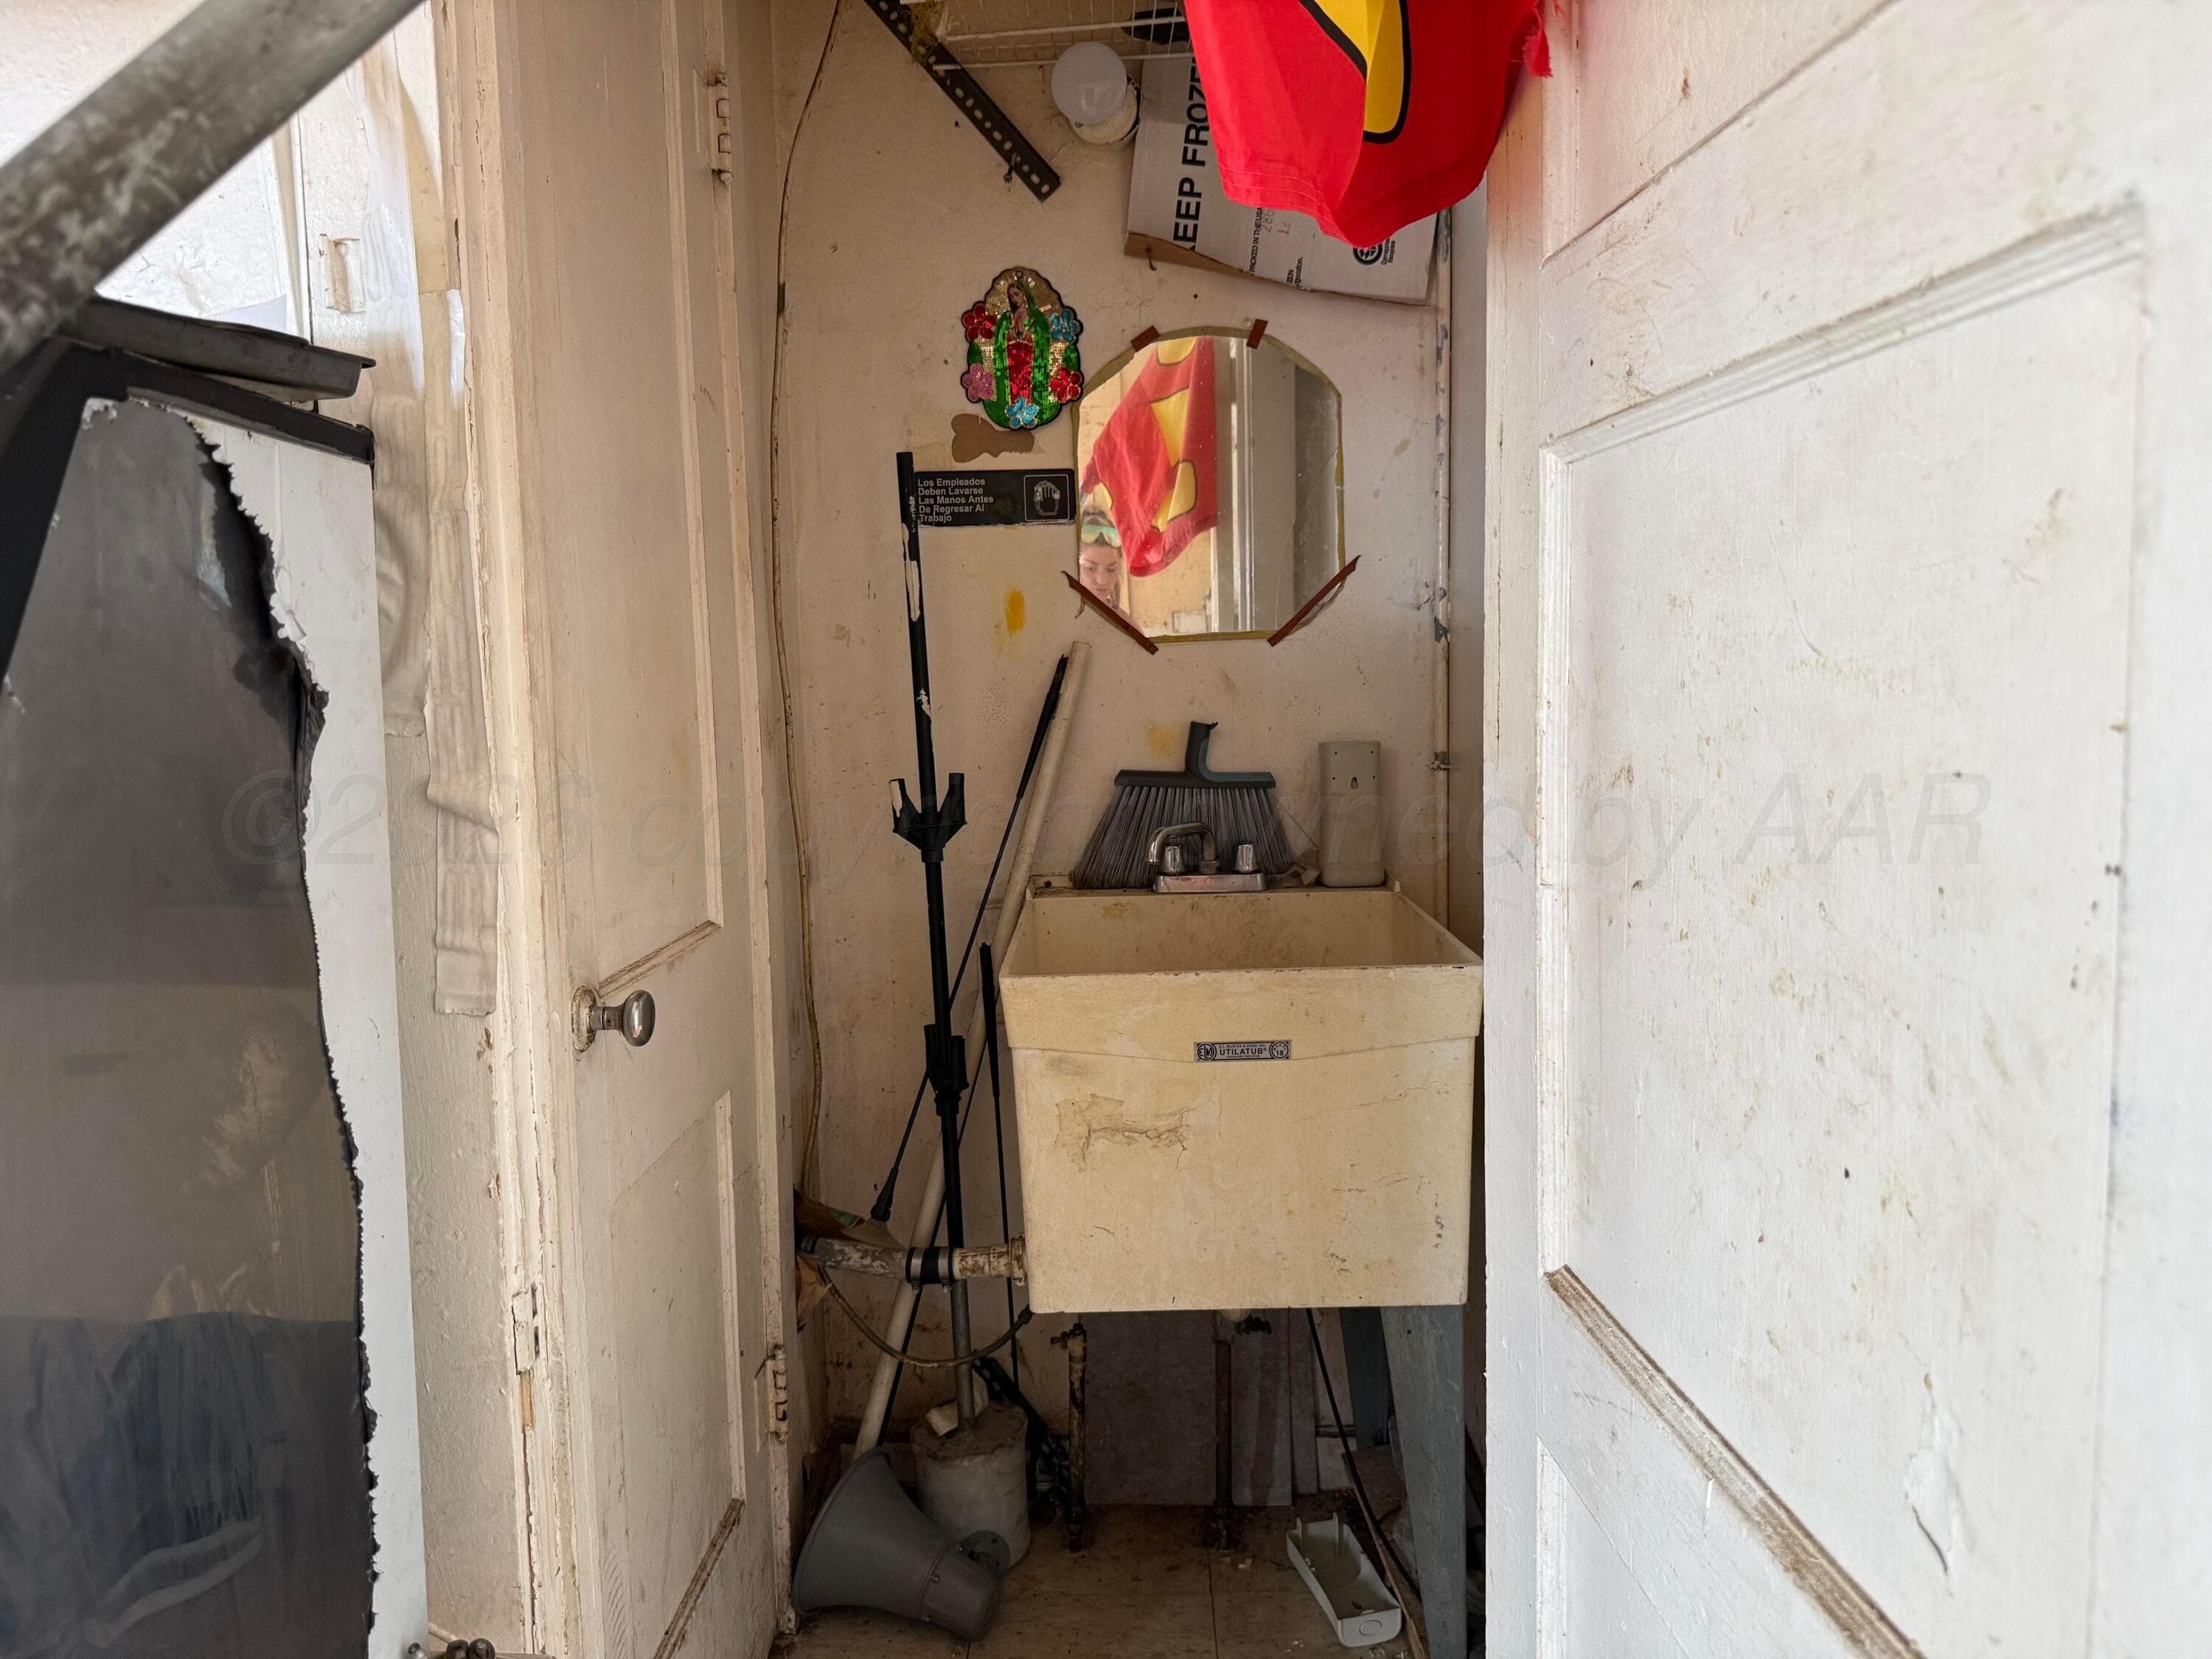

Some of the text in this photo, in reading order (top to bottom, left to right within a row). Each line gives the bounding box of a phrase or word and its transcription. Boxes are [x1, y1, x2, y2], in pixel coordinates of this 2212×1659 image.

[1173, 177, 1202, 252] EEP
[1253, 220, 1262, 236] THE
[1253, 237, 1259, 245] IN
[1249, 246, 1258, 273] PACKED
[917, 478, 986, 487] Los Empleados
[918, 487, 983, 495] Deben Lavarse
[919, 495, 994, 504] Las Manos Antes
[919, 504, 984, 515] De Regresar Al
[919, 514, 953, 524] Trabajo
